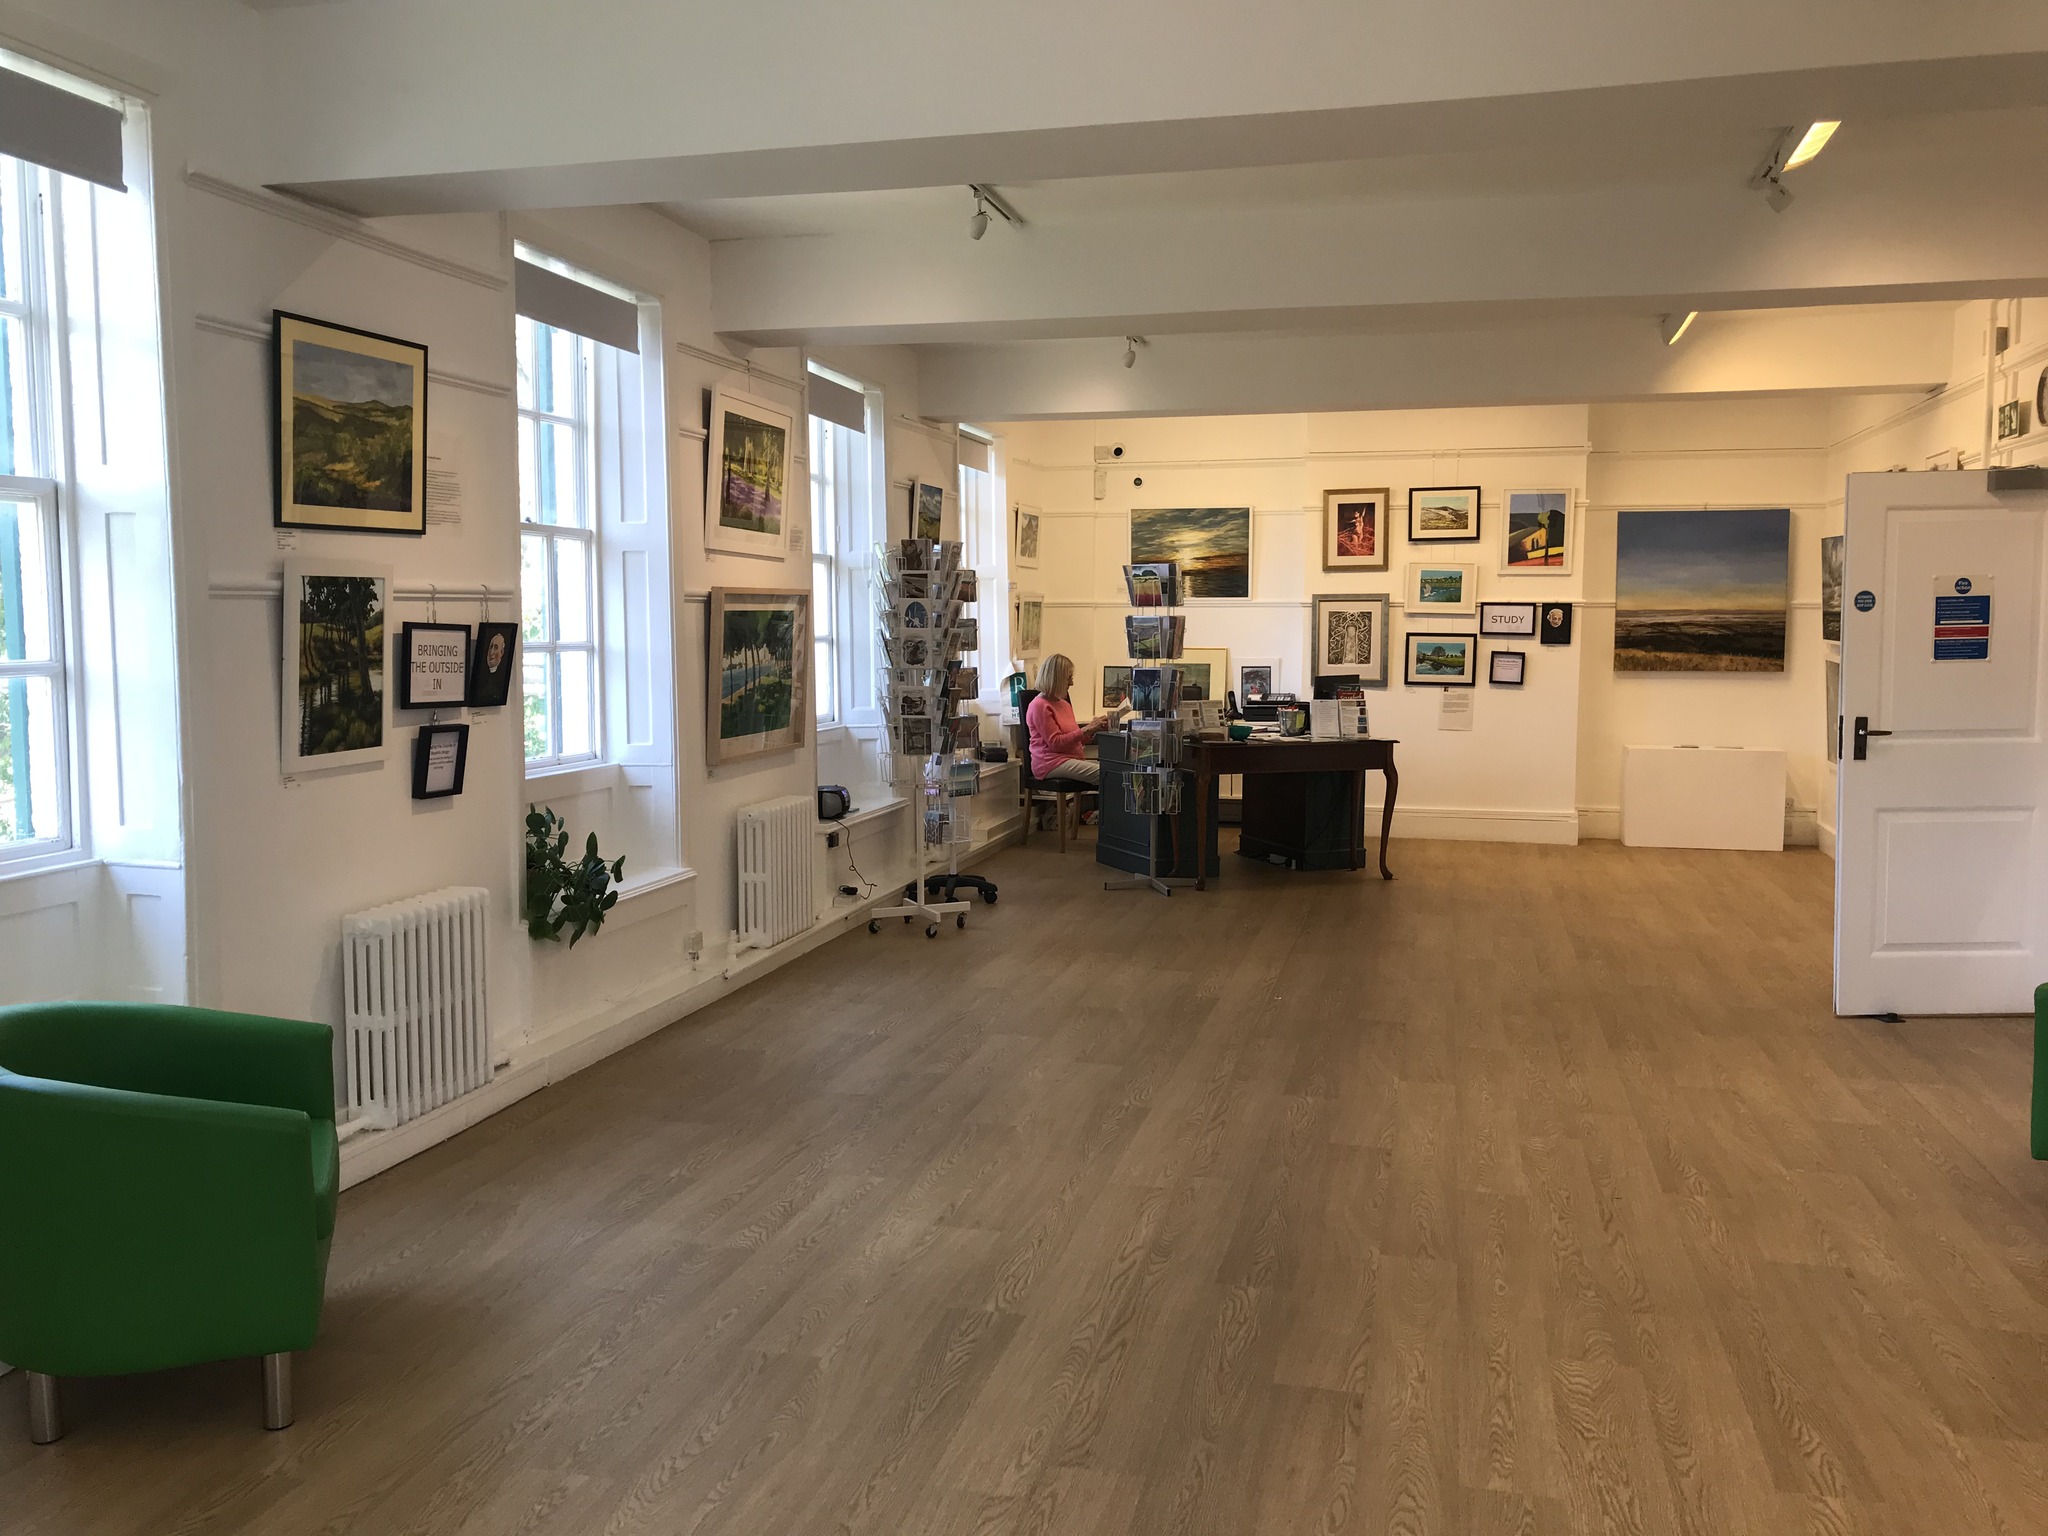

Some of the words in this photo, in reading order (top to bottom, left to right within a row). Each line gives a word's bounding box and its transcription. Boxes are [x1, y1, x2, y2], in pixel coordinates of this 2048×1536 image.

[1491, 615, 1525, 624] STUDY
[417, 644, 458, 657] BRINGING
[410, 661, 427, 673] THE
[428, 661, 464, 673] OUTSIDE
[432, 678, 442, 690] IN
